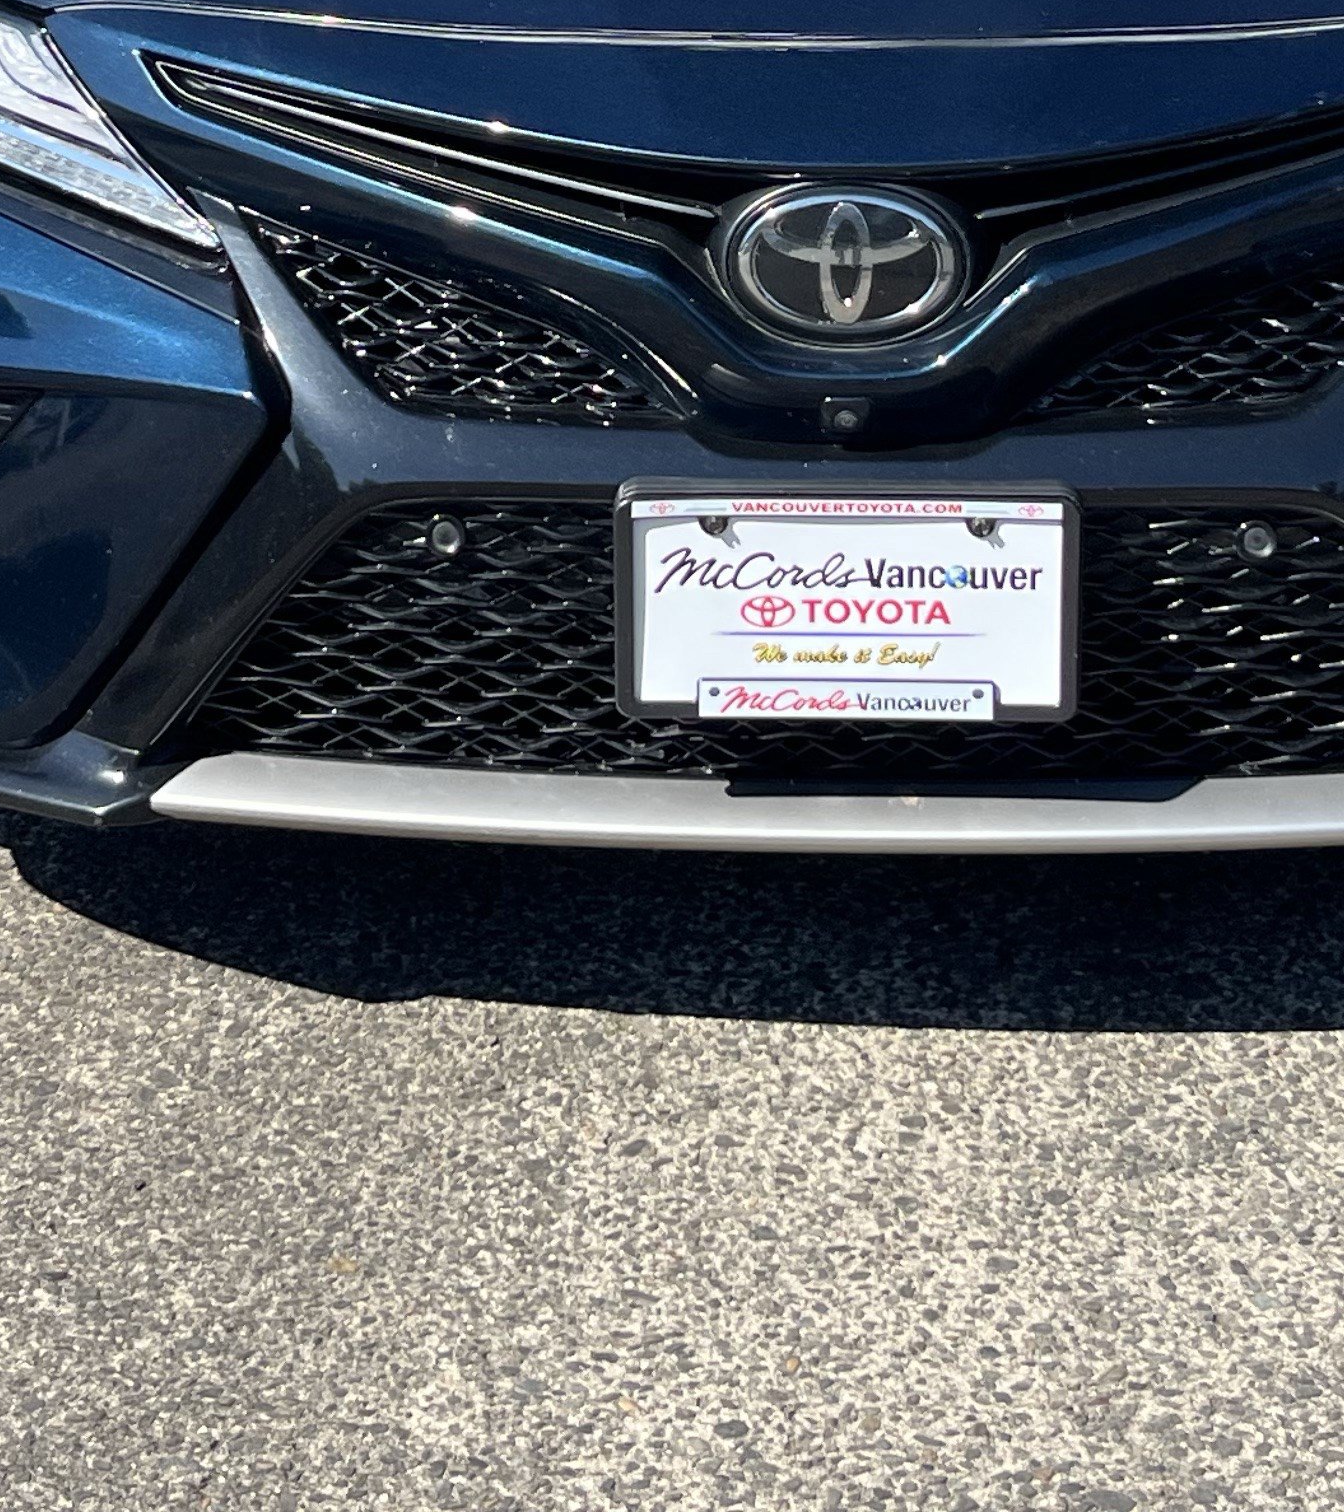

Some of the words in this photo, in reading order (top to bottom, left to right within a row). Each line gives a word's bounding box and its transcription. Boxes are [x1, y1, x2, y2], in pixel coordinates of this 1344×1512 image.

[732, 501, 963, 515] VANCOUVERTOYOTA.COM
[654, 547, 869, 594] McCords
[864, 557, 1044, 590] Vancouver
[802, 599, 951, 625] TOYOTA
[752, 642, 788, 663] We
[793, 643, 848, 663] make
[854, 647, 872, 663] it
[877, 641, 942, 669] Easy!
[720, 685, 858, 713] McCords
[857, 691, 972, 712] Vancouver
